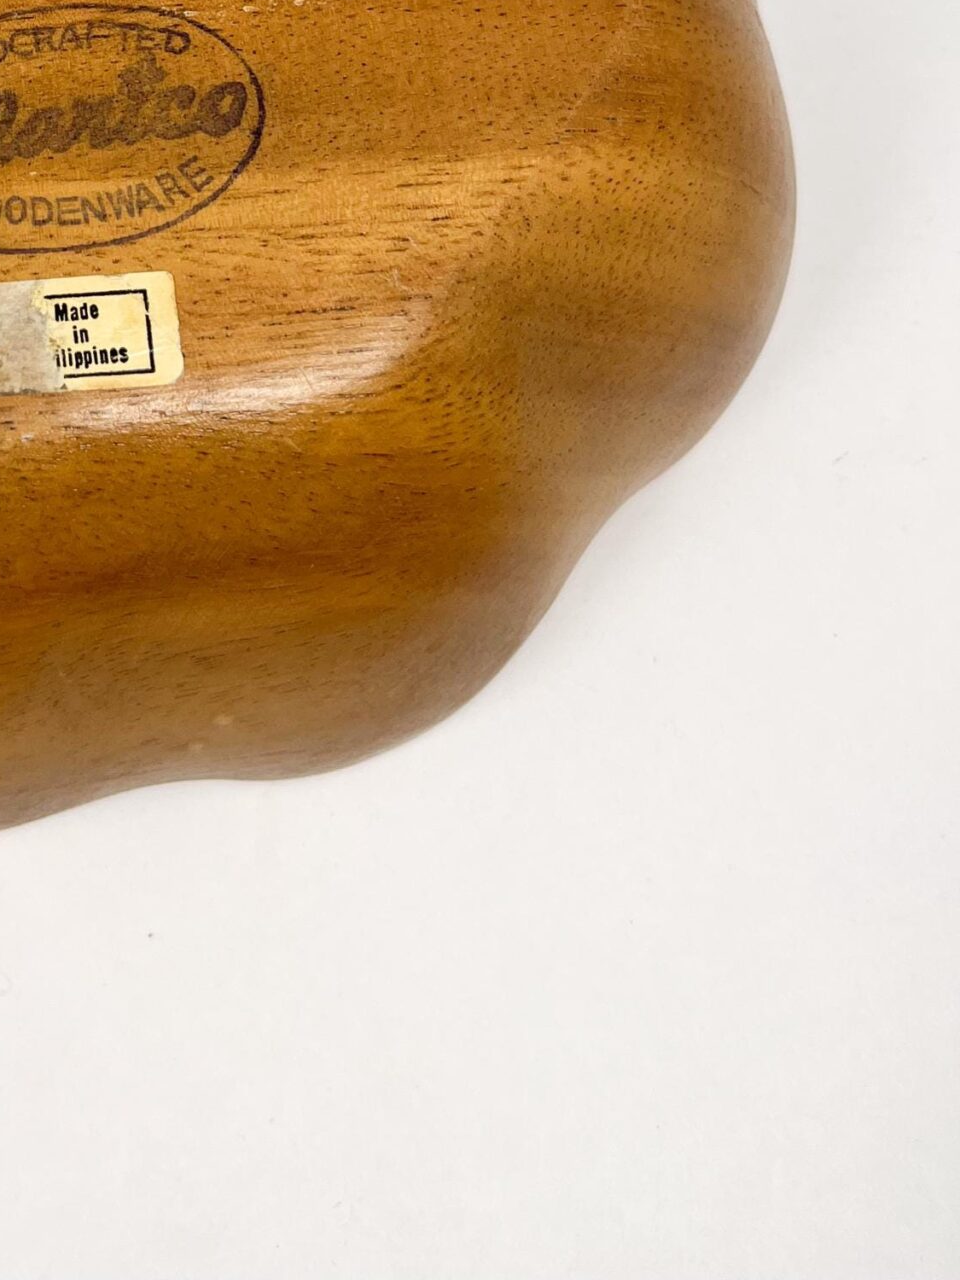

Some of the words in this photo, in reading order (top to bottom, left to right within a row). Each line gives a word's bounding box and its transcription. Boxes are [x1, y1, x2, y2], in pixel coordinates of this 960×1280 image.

[54, 303, 99, 321] Made
[73, 326, 89, 344] in
[55, 347, 129, 369] ilippines
